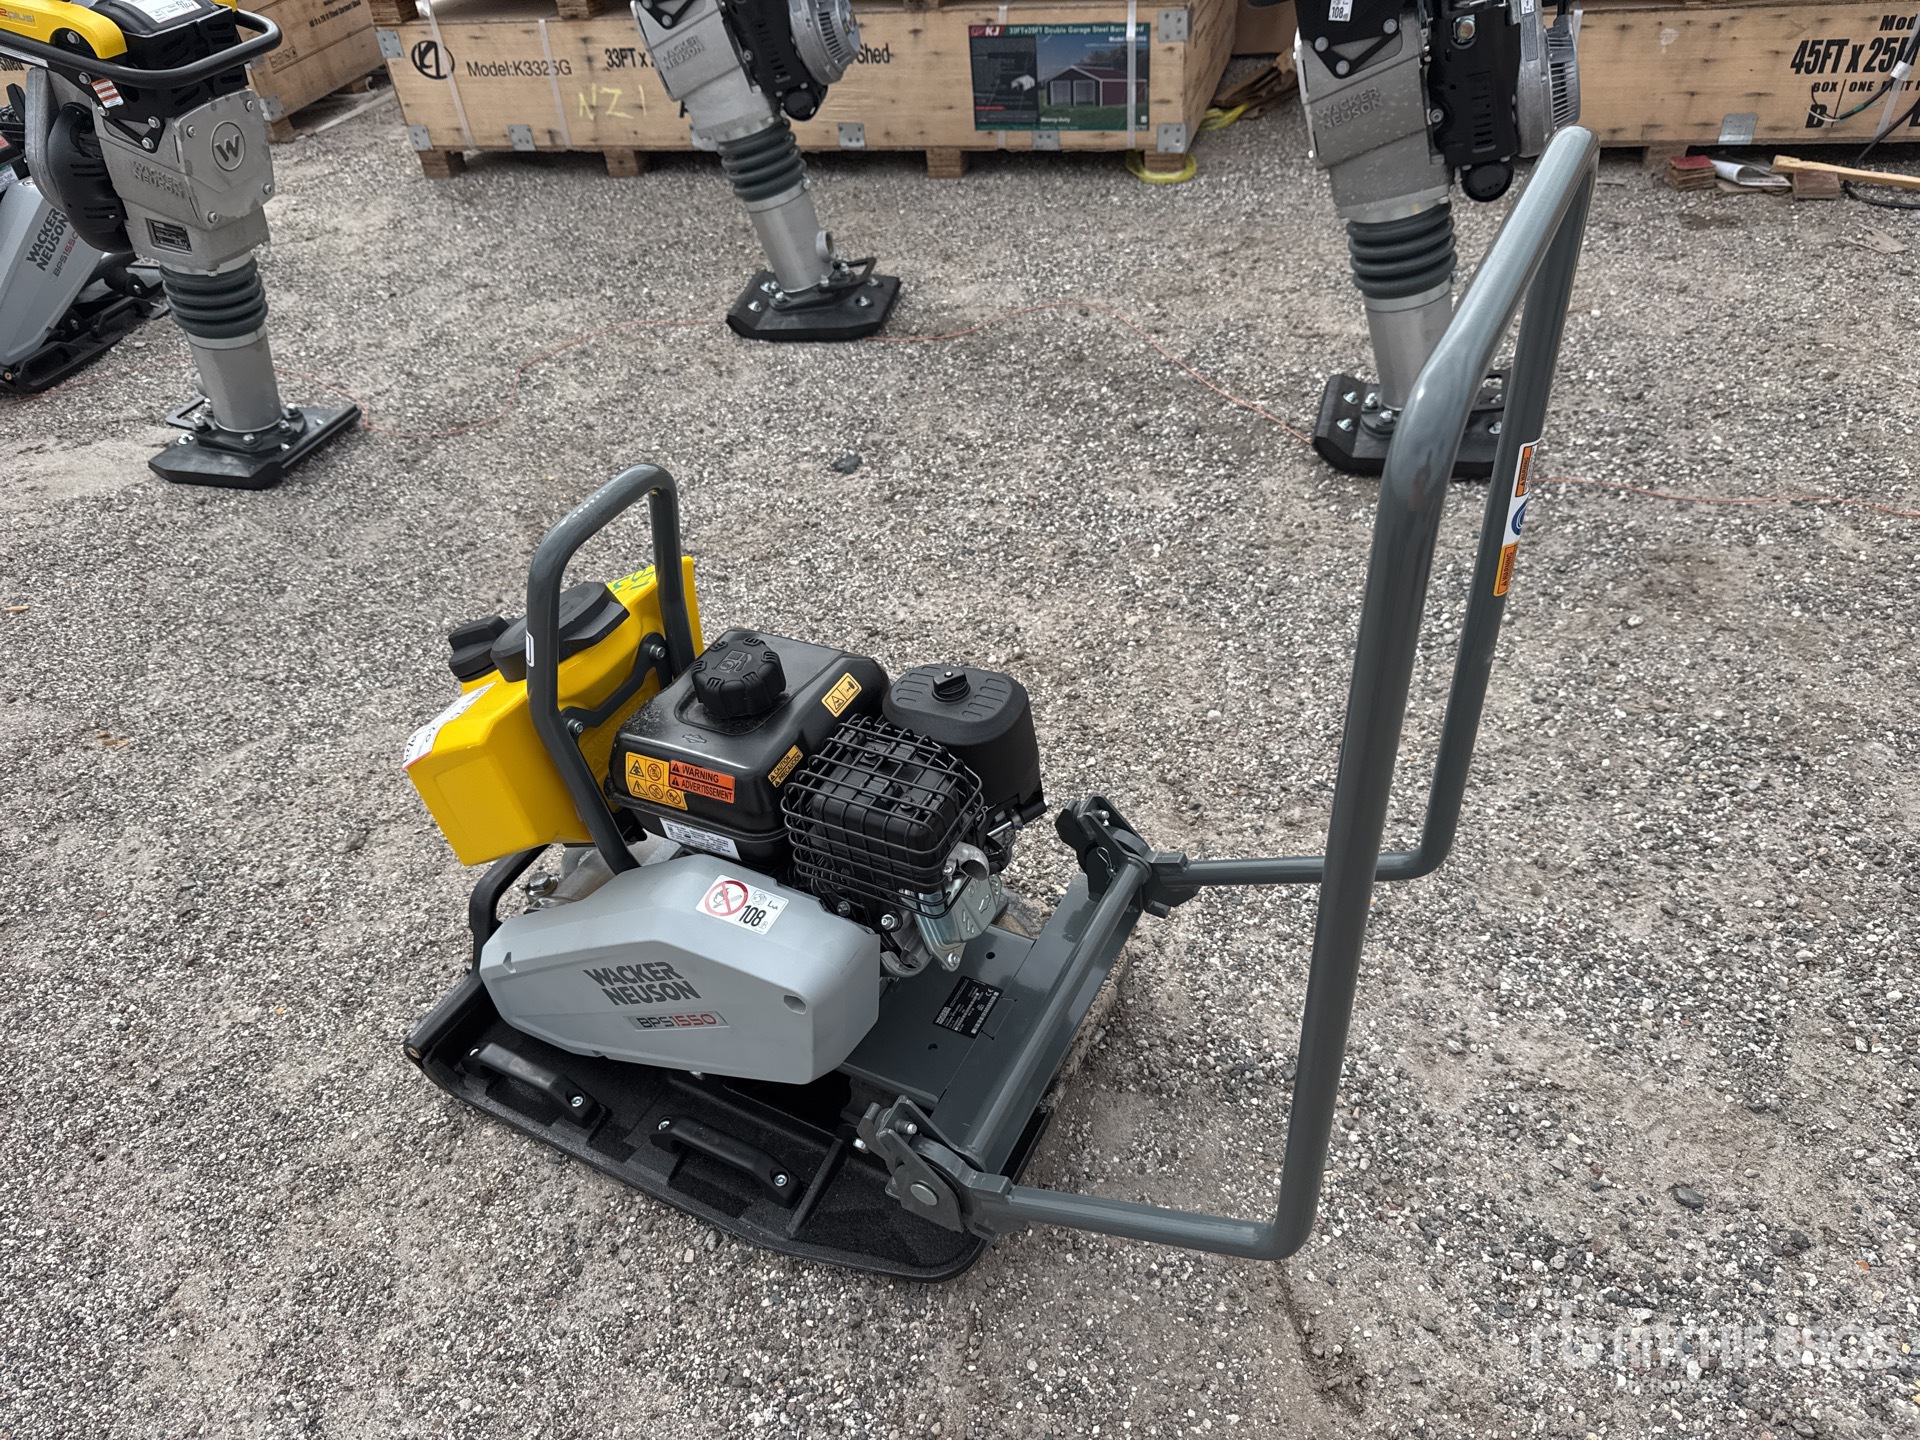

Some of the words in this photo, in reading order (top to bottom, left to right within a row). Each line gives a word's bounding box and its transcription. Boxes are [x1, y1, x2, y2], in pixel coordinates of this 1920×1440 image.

[985, 26, 1000, 36] KJ
[605, 48, 636, 68] 33FT
[1790, 39, 1850, 74] 45FT
[1813, 81, 1838, 92] BOX
[1848, 81, 1874, 92] ONE
[1316, 87, 1381, 118] WACKER
[1319, 100, 1382, 130] NEUSON
[26, 208, 61, 263] WACKER
[36, 213, 69, 271] NEUSON
[682, 764, 719, 784] WARNING
[774, 755, 790, 775] CAUTION
[739, 904, 766, 927] 108
[583, 961, 684, 987] WACKER
[602, 980, 702, 1006] NEUSON
[636, 1013, 718, 1028] BPS1550
